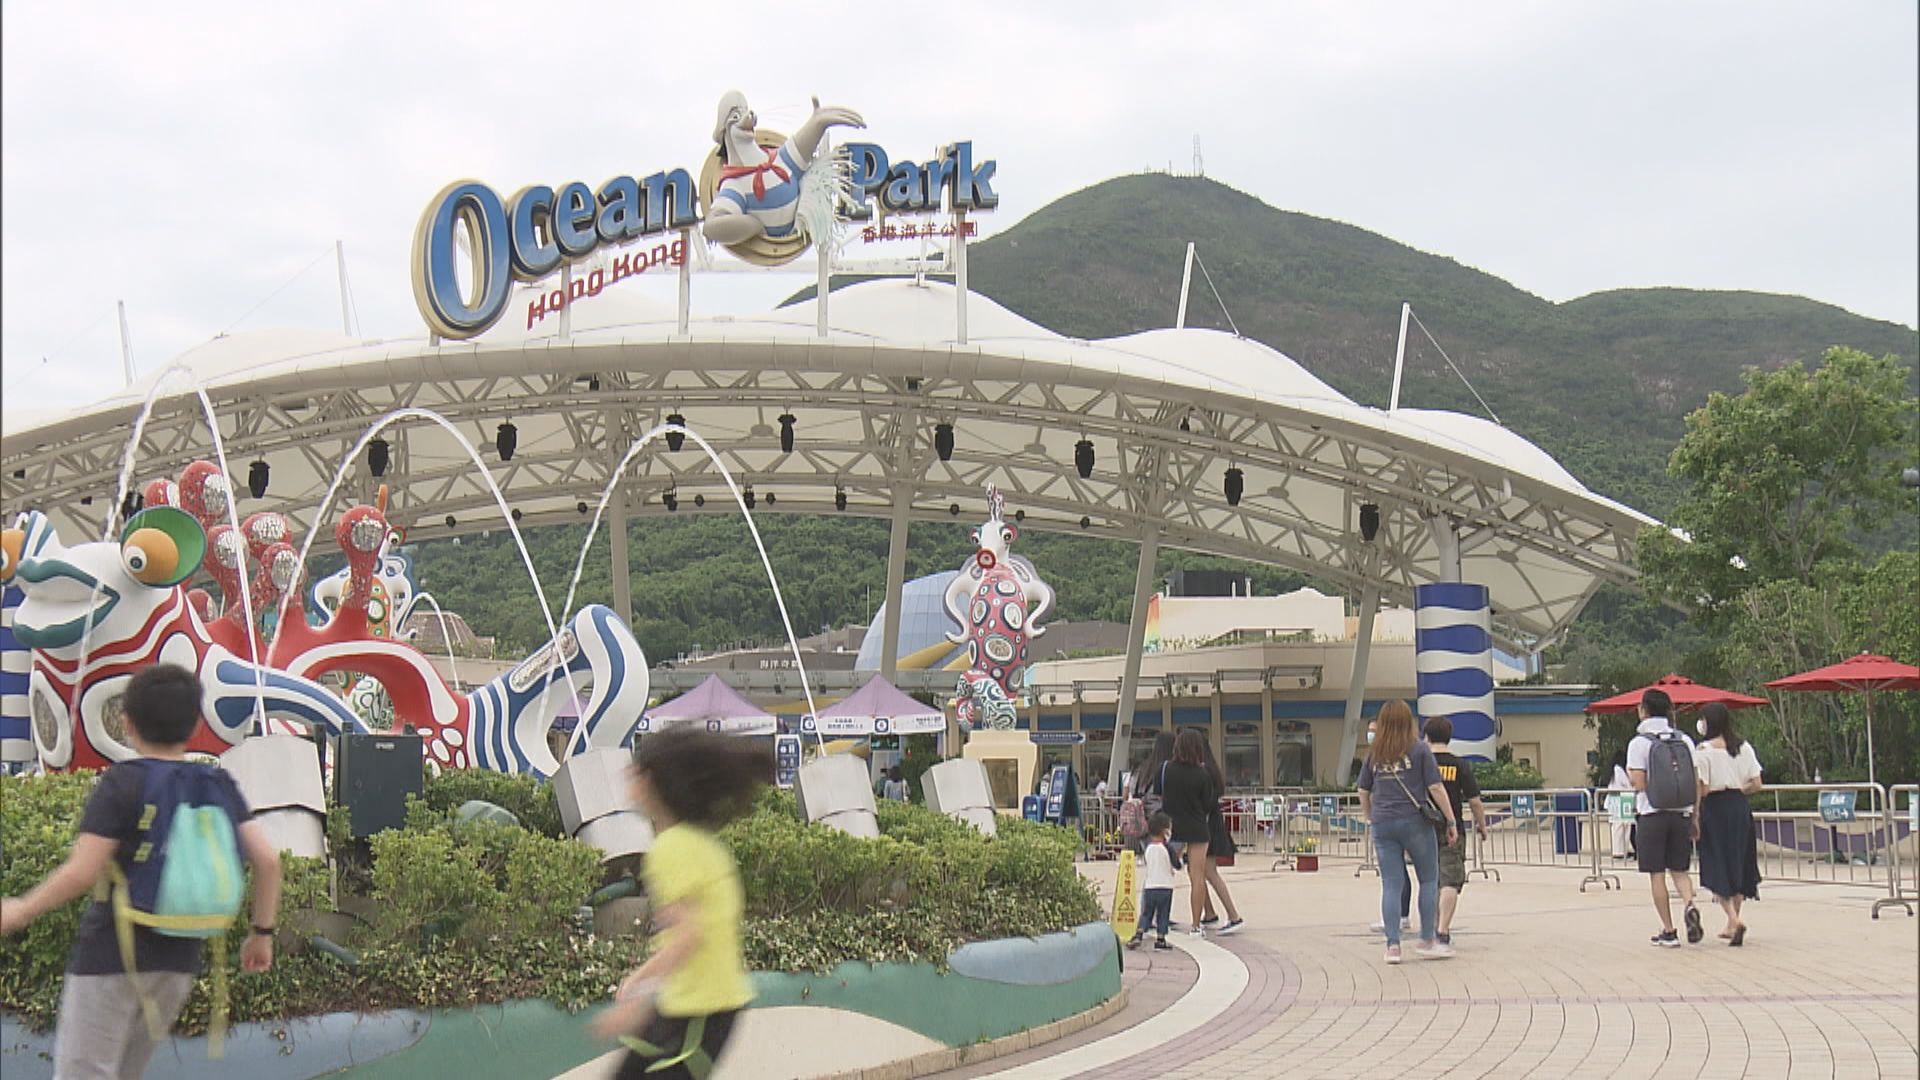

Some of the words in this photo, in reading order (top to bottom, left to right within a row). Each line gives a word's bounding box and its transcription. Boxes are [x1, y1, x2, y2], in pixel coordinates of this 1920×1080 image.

[411, 167, 698, 340] Ocean
[835, 139, 998, 220] Park
[527, 268, 604, 330] Hong
[612, 239, 686, 284] Kong
